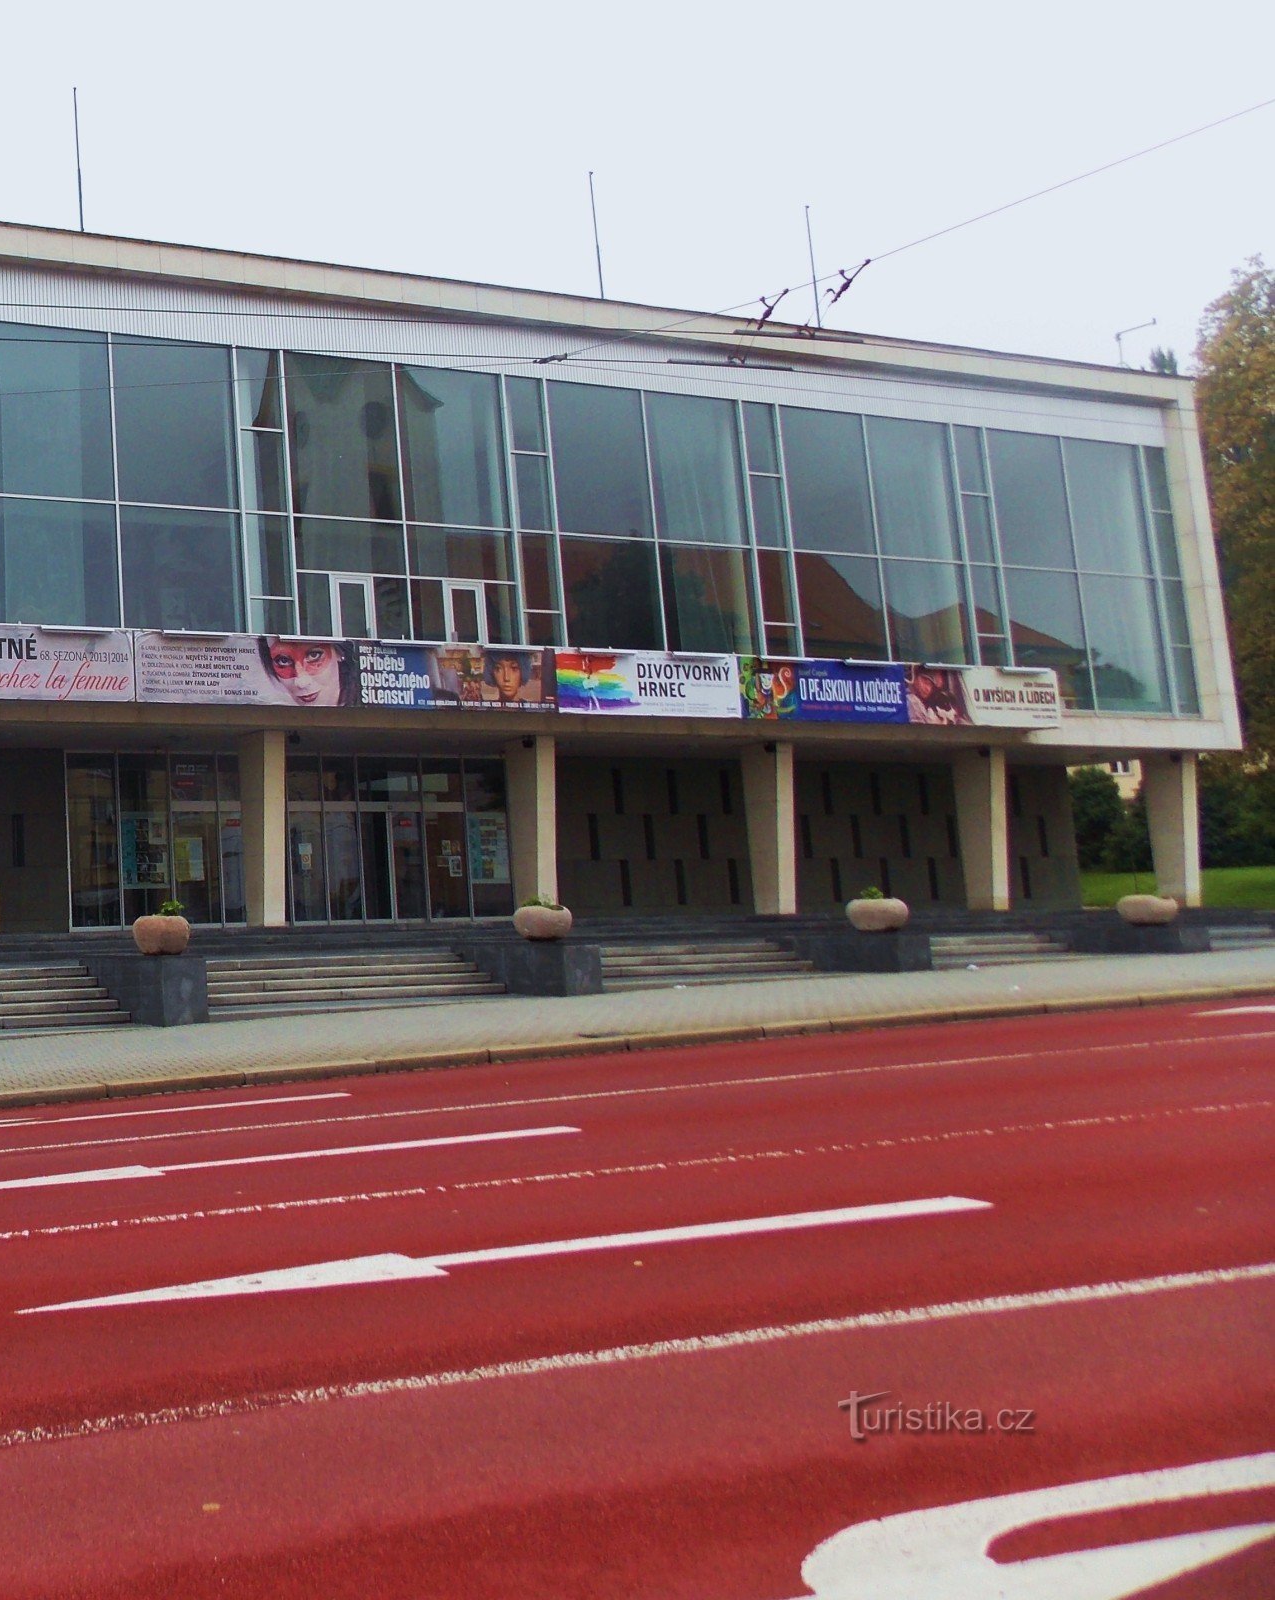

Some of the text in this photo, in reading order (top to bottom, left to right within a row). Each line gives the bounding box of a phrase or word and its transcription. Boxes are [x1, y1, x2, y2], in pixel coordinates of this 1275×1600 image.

[39, 651, 51, 661] 68.
[45, 660, 66, 690] la
[58, 660, 129, 701] femme
[636, 662, 730, 682] DIVOTVORNÝ
[638, 681, 686, 698] HRNEC
[799, 678, 903, 704] O PEJSKOVI A KOČIČCE
[973, 686, 1056, 705] O MYŠÍCH A LIDECH
